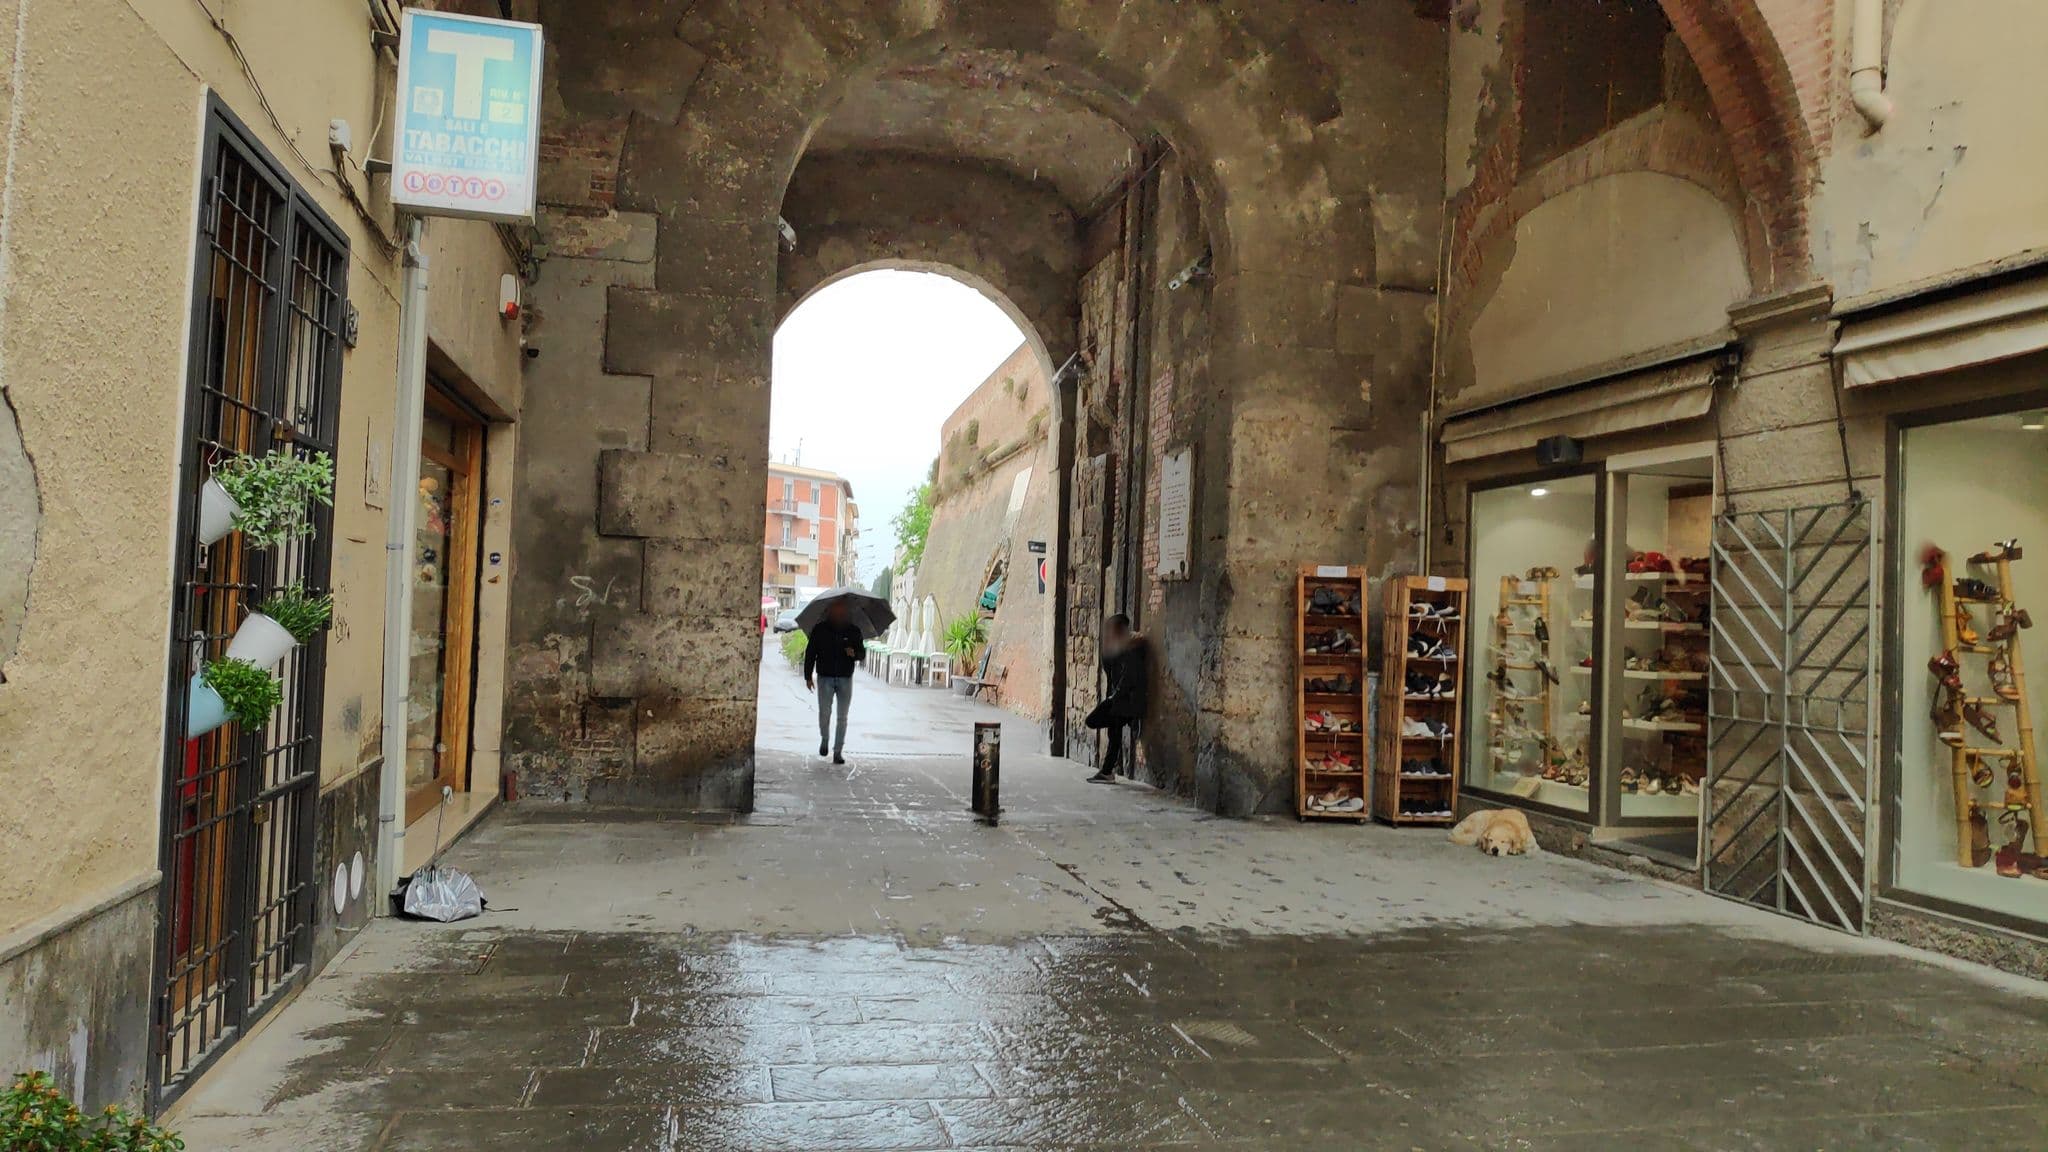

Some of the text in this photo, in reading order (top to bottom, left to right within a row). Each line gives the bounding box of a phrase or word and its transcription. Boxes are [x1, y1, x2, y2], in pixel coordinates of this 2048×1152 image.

[446, 119, 475, 133] SALI
[406, 129, 525, 162] TABACCHI
[406, 173, 503, 198] LOTTO
